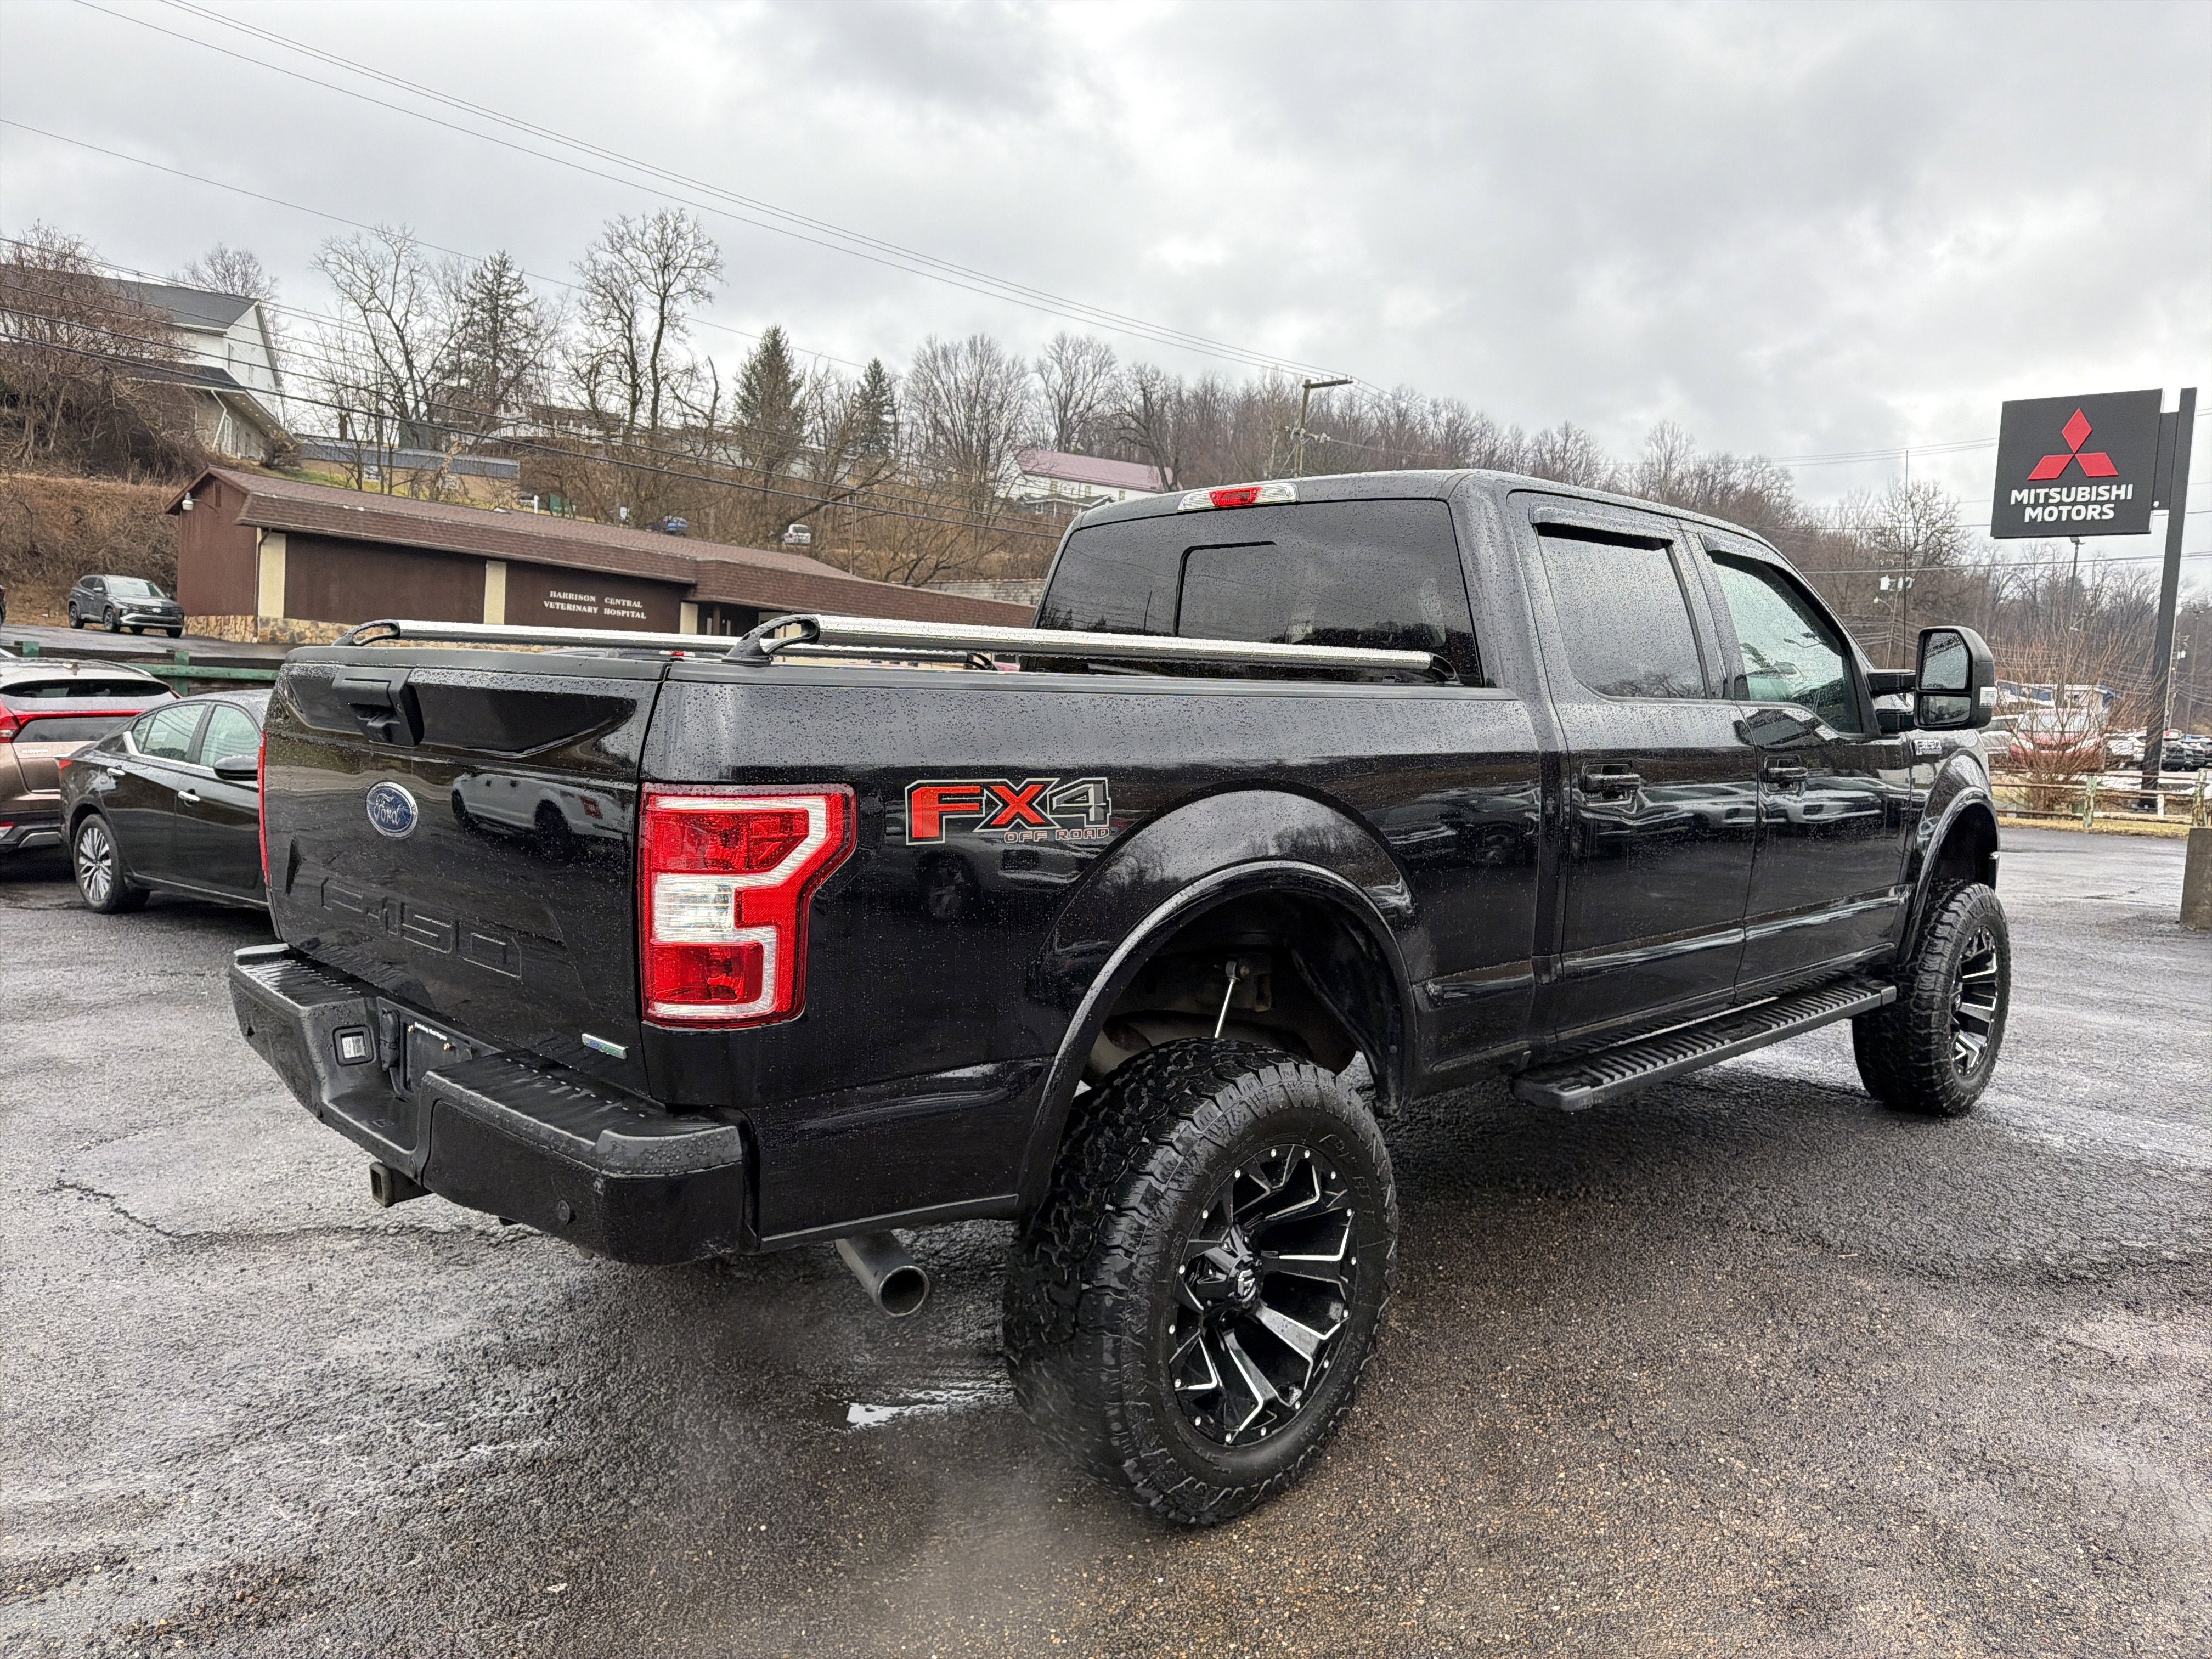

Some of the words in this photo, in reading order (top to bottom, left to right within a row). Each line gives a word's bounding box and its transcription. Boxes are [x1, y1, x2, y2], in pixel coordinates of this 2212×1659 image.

[2010, 484, 2134, 505] MITSUBISHI
[2024, 503, 2115, 522] MOTORS
[550, 590, 596, 602] HARRISON
[604, 597, 643, 608] CENTRAL
[543, 601, 599, 614] VETERINARY
[603, 607, 647, 619] HOSPITAL
[373, 793, 402, 826] Ford
[905, 777, 1112, 846] FX4
[1003, 830, 1048, 844] OFF
[1055, 827, 1110, 842] ROAD
